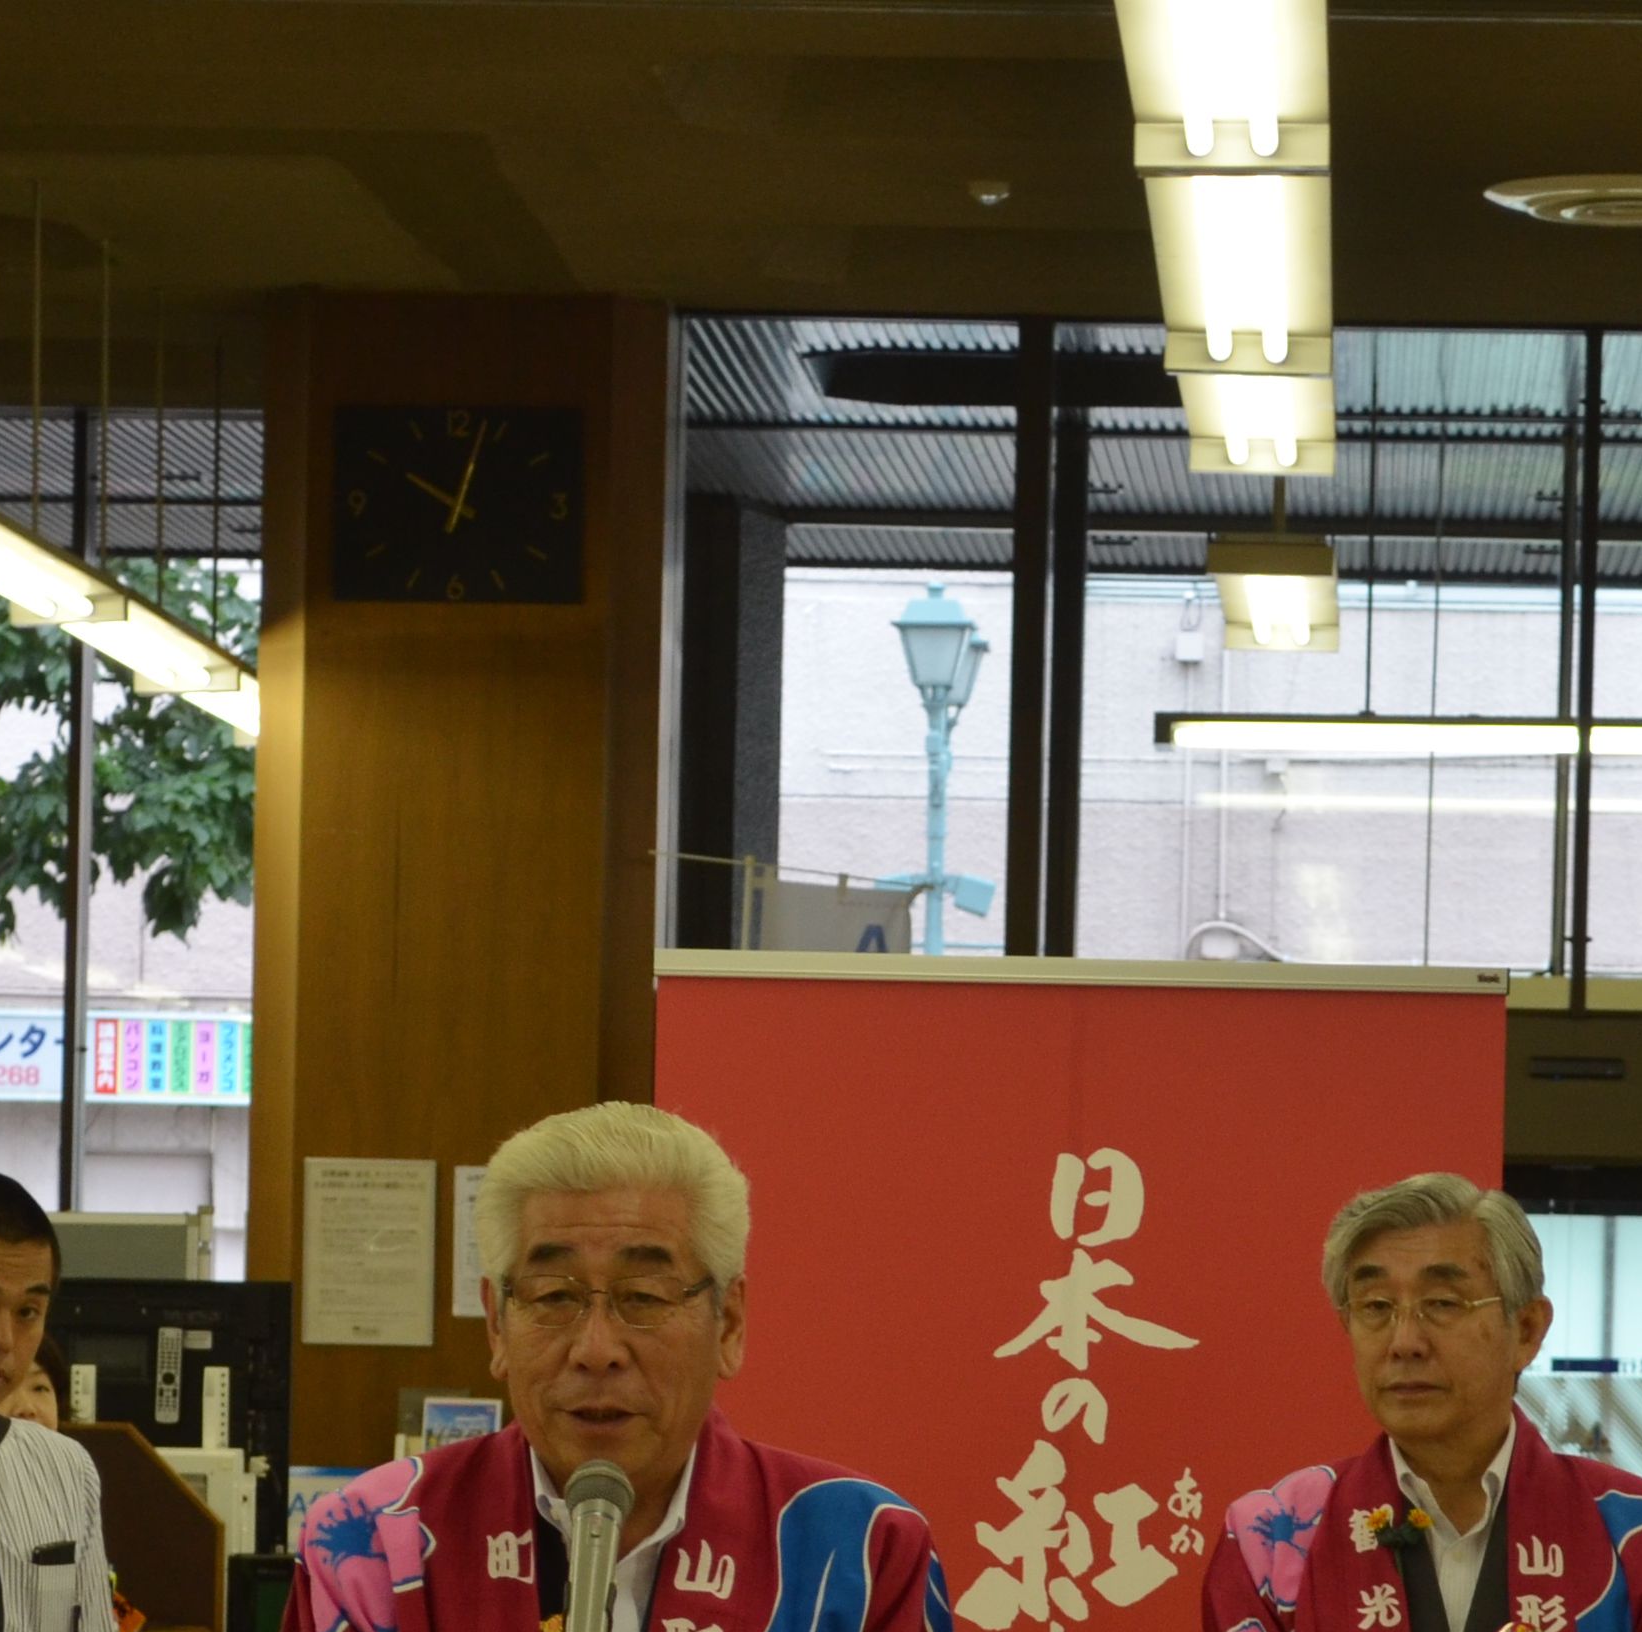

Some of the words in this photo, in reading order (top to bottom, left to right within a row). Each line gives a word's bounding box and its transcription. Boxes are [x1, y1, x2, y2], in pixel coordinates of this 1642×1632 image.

[445, 409, 470, 438] 12
[347, 489, 368, 518] 9
[550, 492, 569, 520] 3
[446, 575, 465, 600] 6
[125, 1023, 140, 1089] パソコン
[198, 1030, 210, 1083] ヨーガ
[1167, 1467, 1205, 1556] あか
